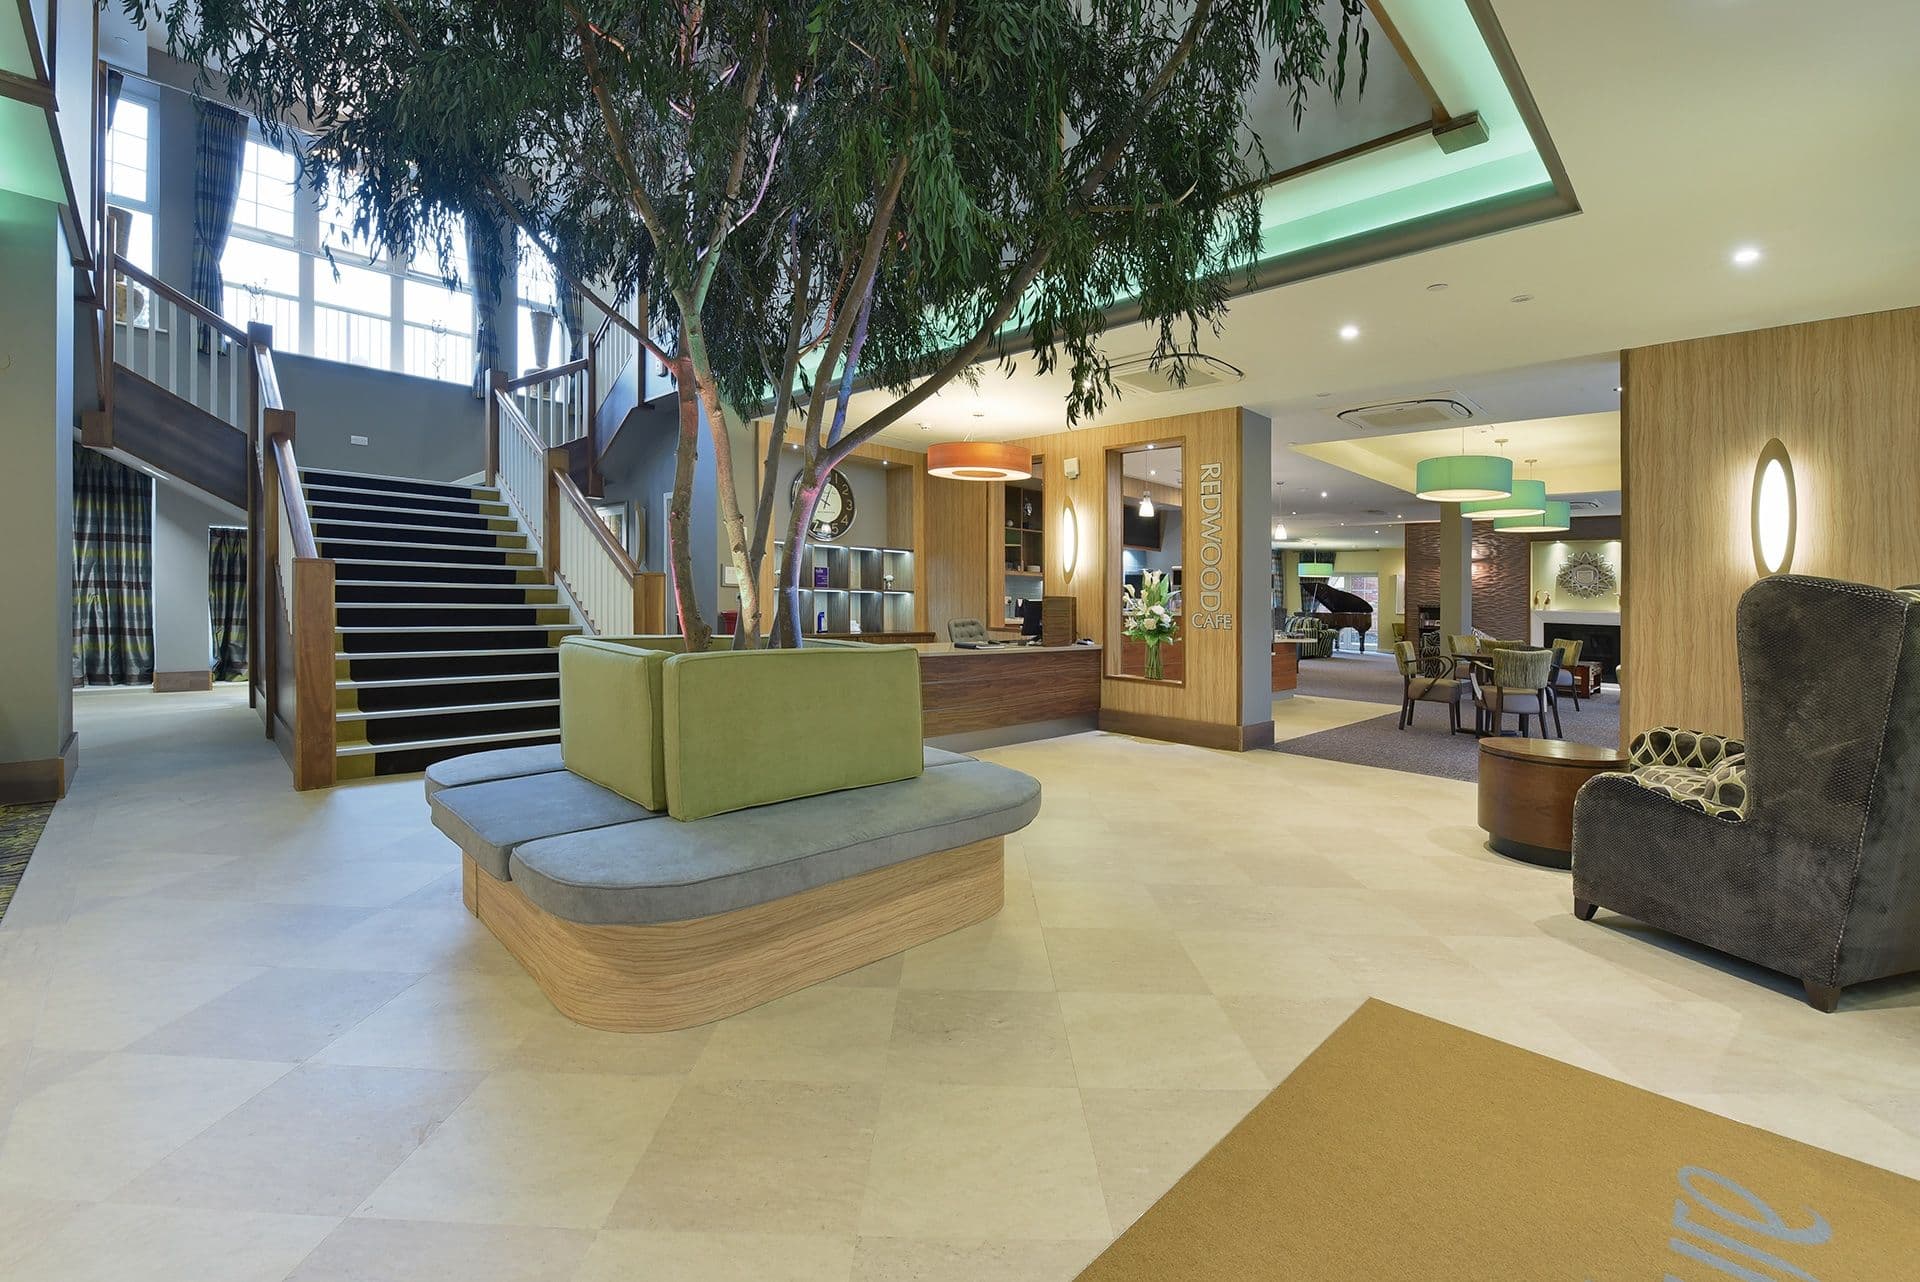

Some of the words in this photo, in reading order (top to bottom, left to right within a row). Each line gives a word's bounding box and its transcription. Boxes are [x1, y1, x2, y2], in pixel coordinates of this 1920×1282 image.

[842, 484, 849, 495] 2
[846, 500, 853, 511] 3
[840, 514, 848, 526] 4
[831, 522, 839, 534] 5
[1200, 462, 1222, 612] REDWOOD
